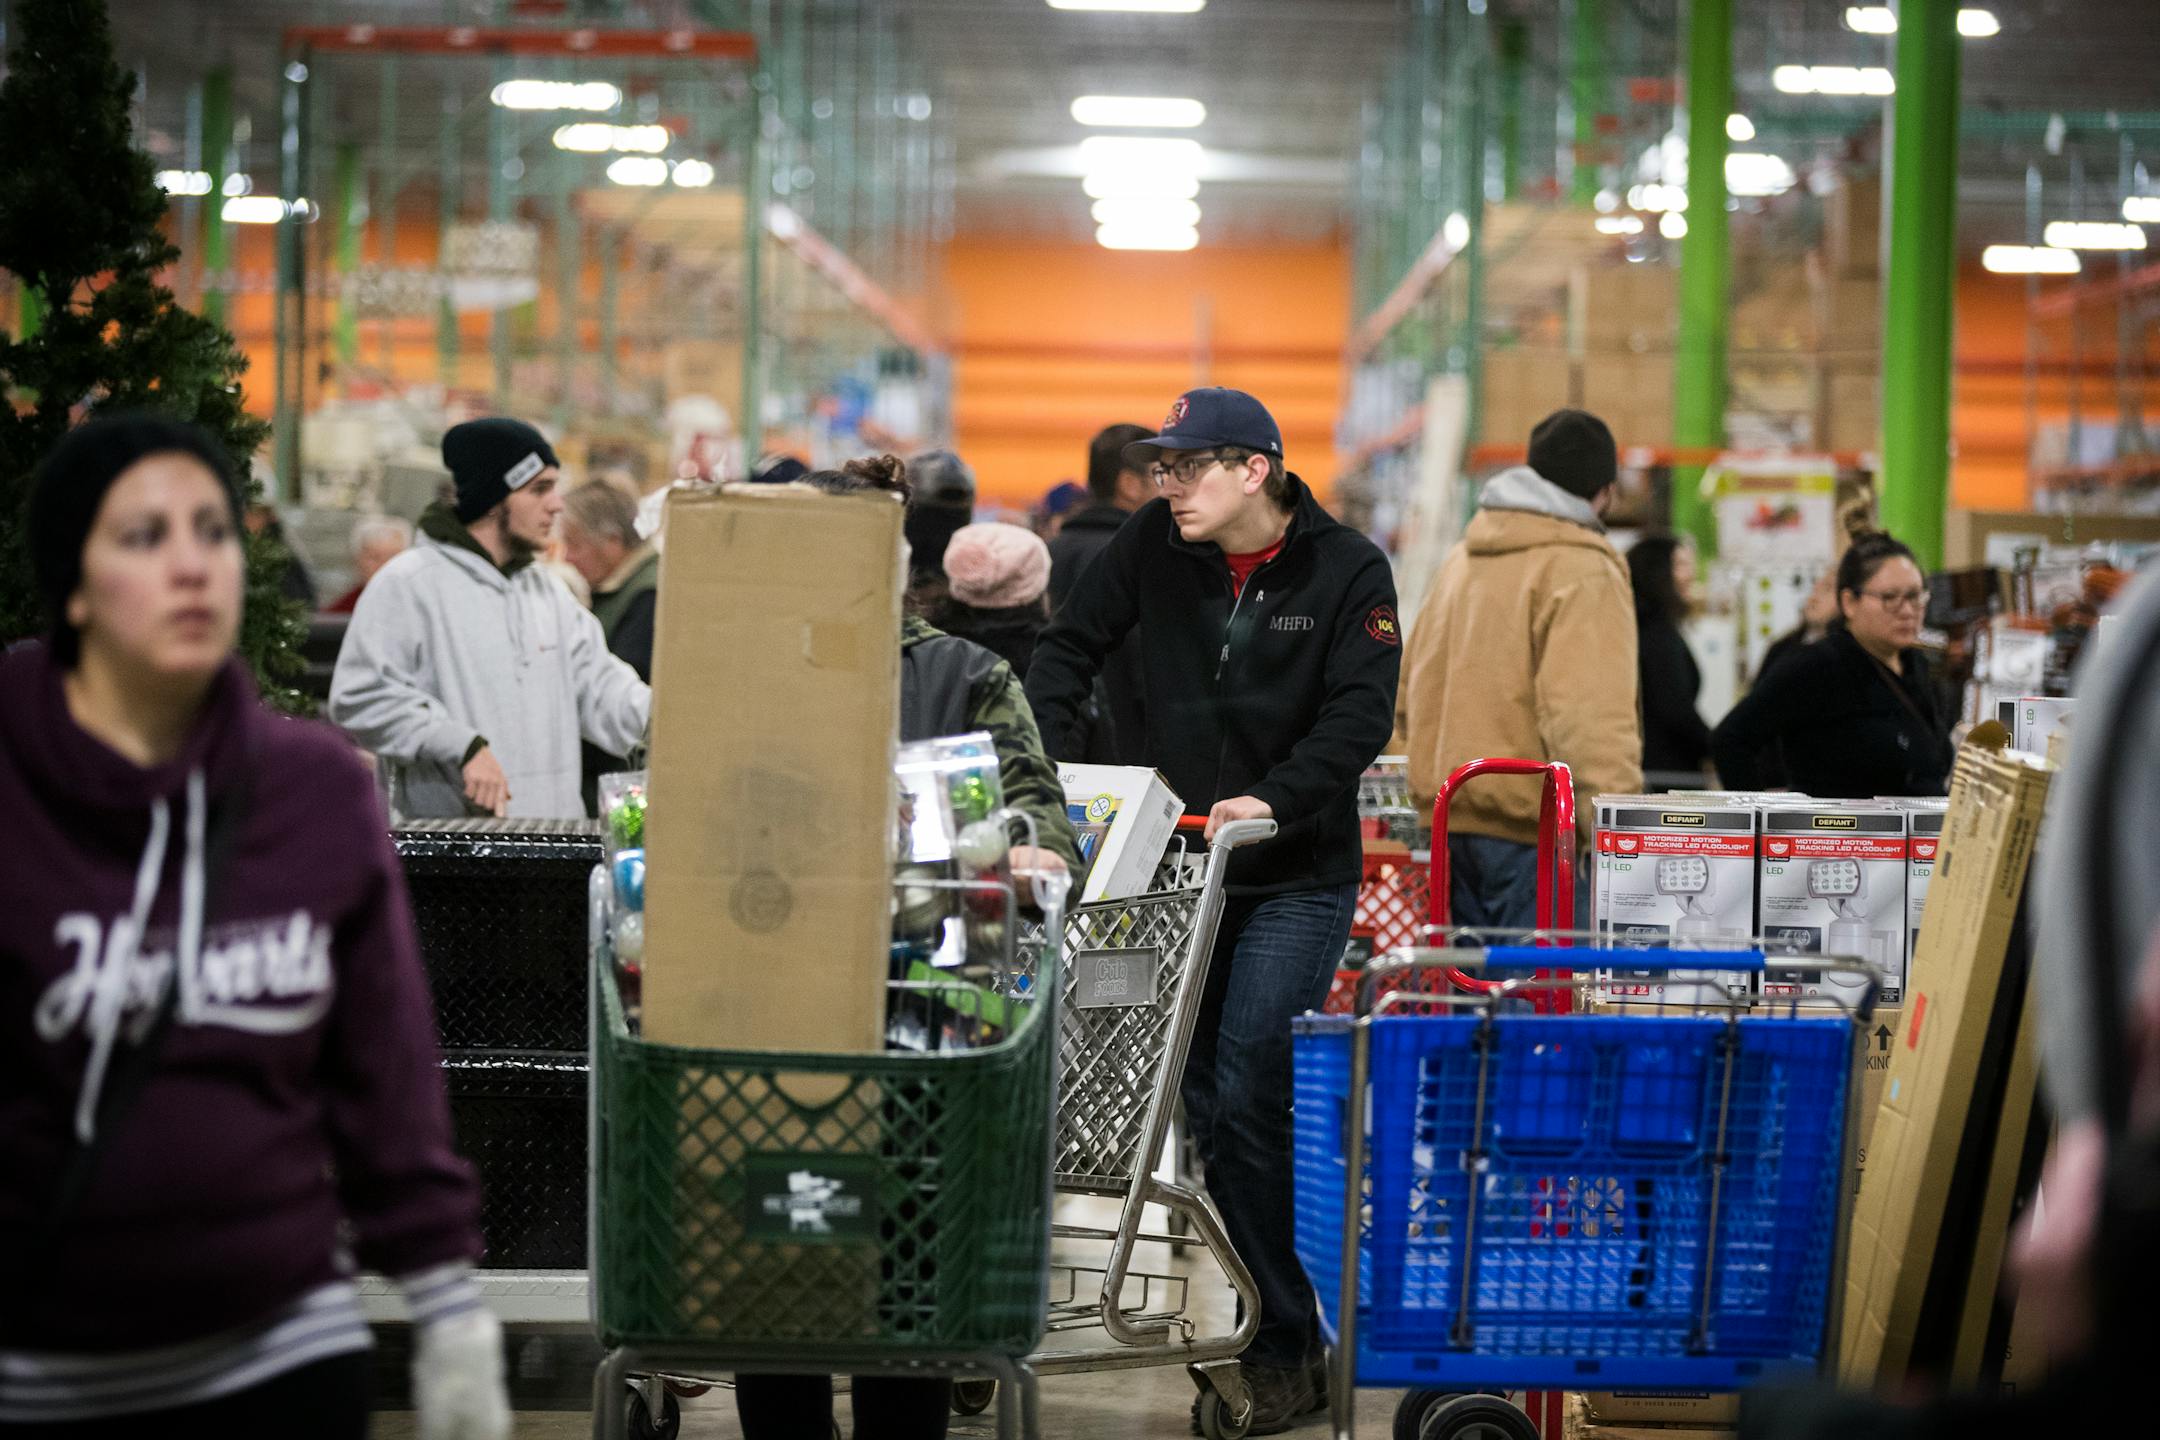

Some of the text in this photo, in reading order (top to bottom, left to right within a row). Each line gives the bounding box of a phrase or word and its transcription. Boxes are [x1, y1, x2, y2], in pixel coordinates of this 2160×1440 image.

[1269, 616, 1314, 631] MHFD
[2027, 708, 2035, 725] LED
[1643, 835, 1688, 843] MOTORIZED
[1701, 843, 1750, 851] FLOODLIGHT
[1766, 867, 1784, 875] LED
[1913, 869, 1930, 877] LED
[1094, 980, 1128, 997] FOODS
